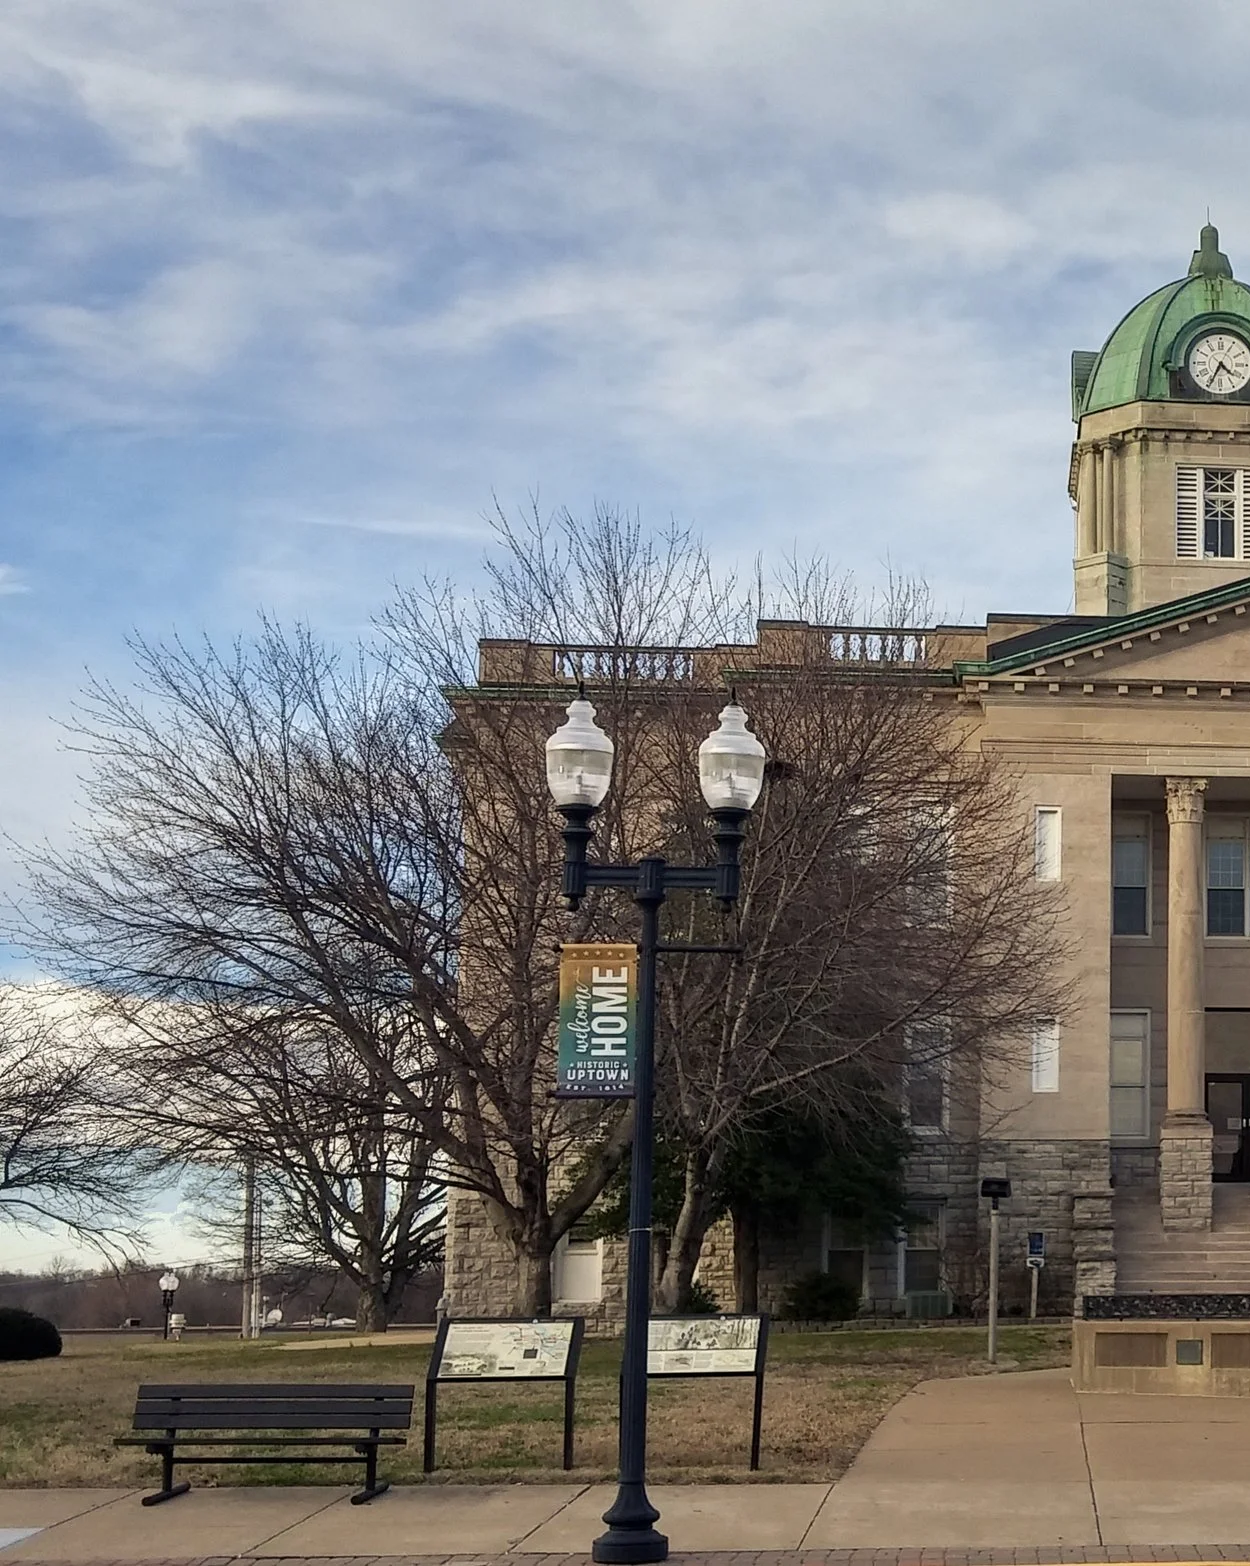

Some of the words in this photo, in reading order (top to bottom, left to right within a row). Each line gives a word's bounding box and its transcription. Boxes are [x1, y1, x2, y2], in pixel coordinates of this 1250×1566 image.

[567, 967, 591, 1053] welcome
[590, 966, 628, 1056] HOME
[567, 1069, 629, 1081] UPTOWN
[576, 1061, 620, 1069] HISTORIC
